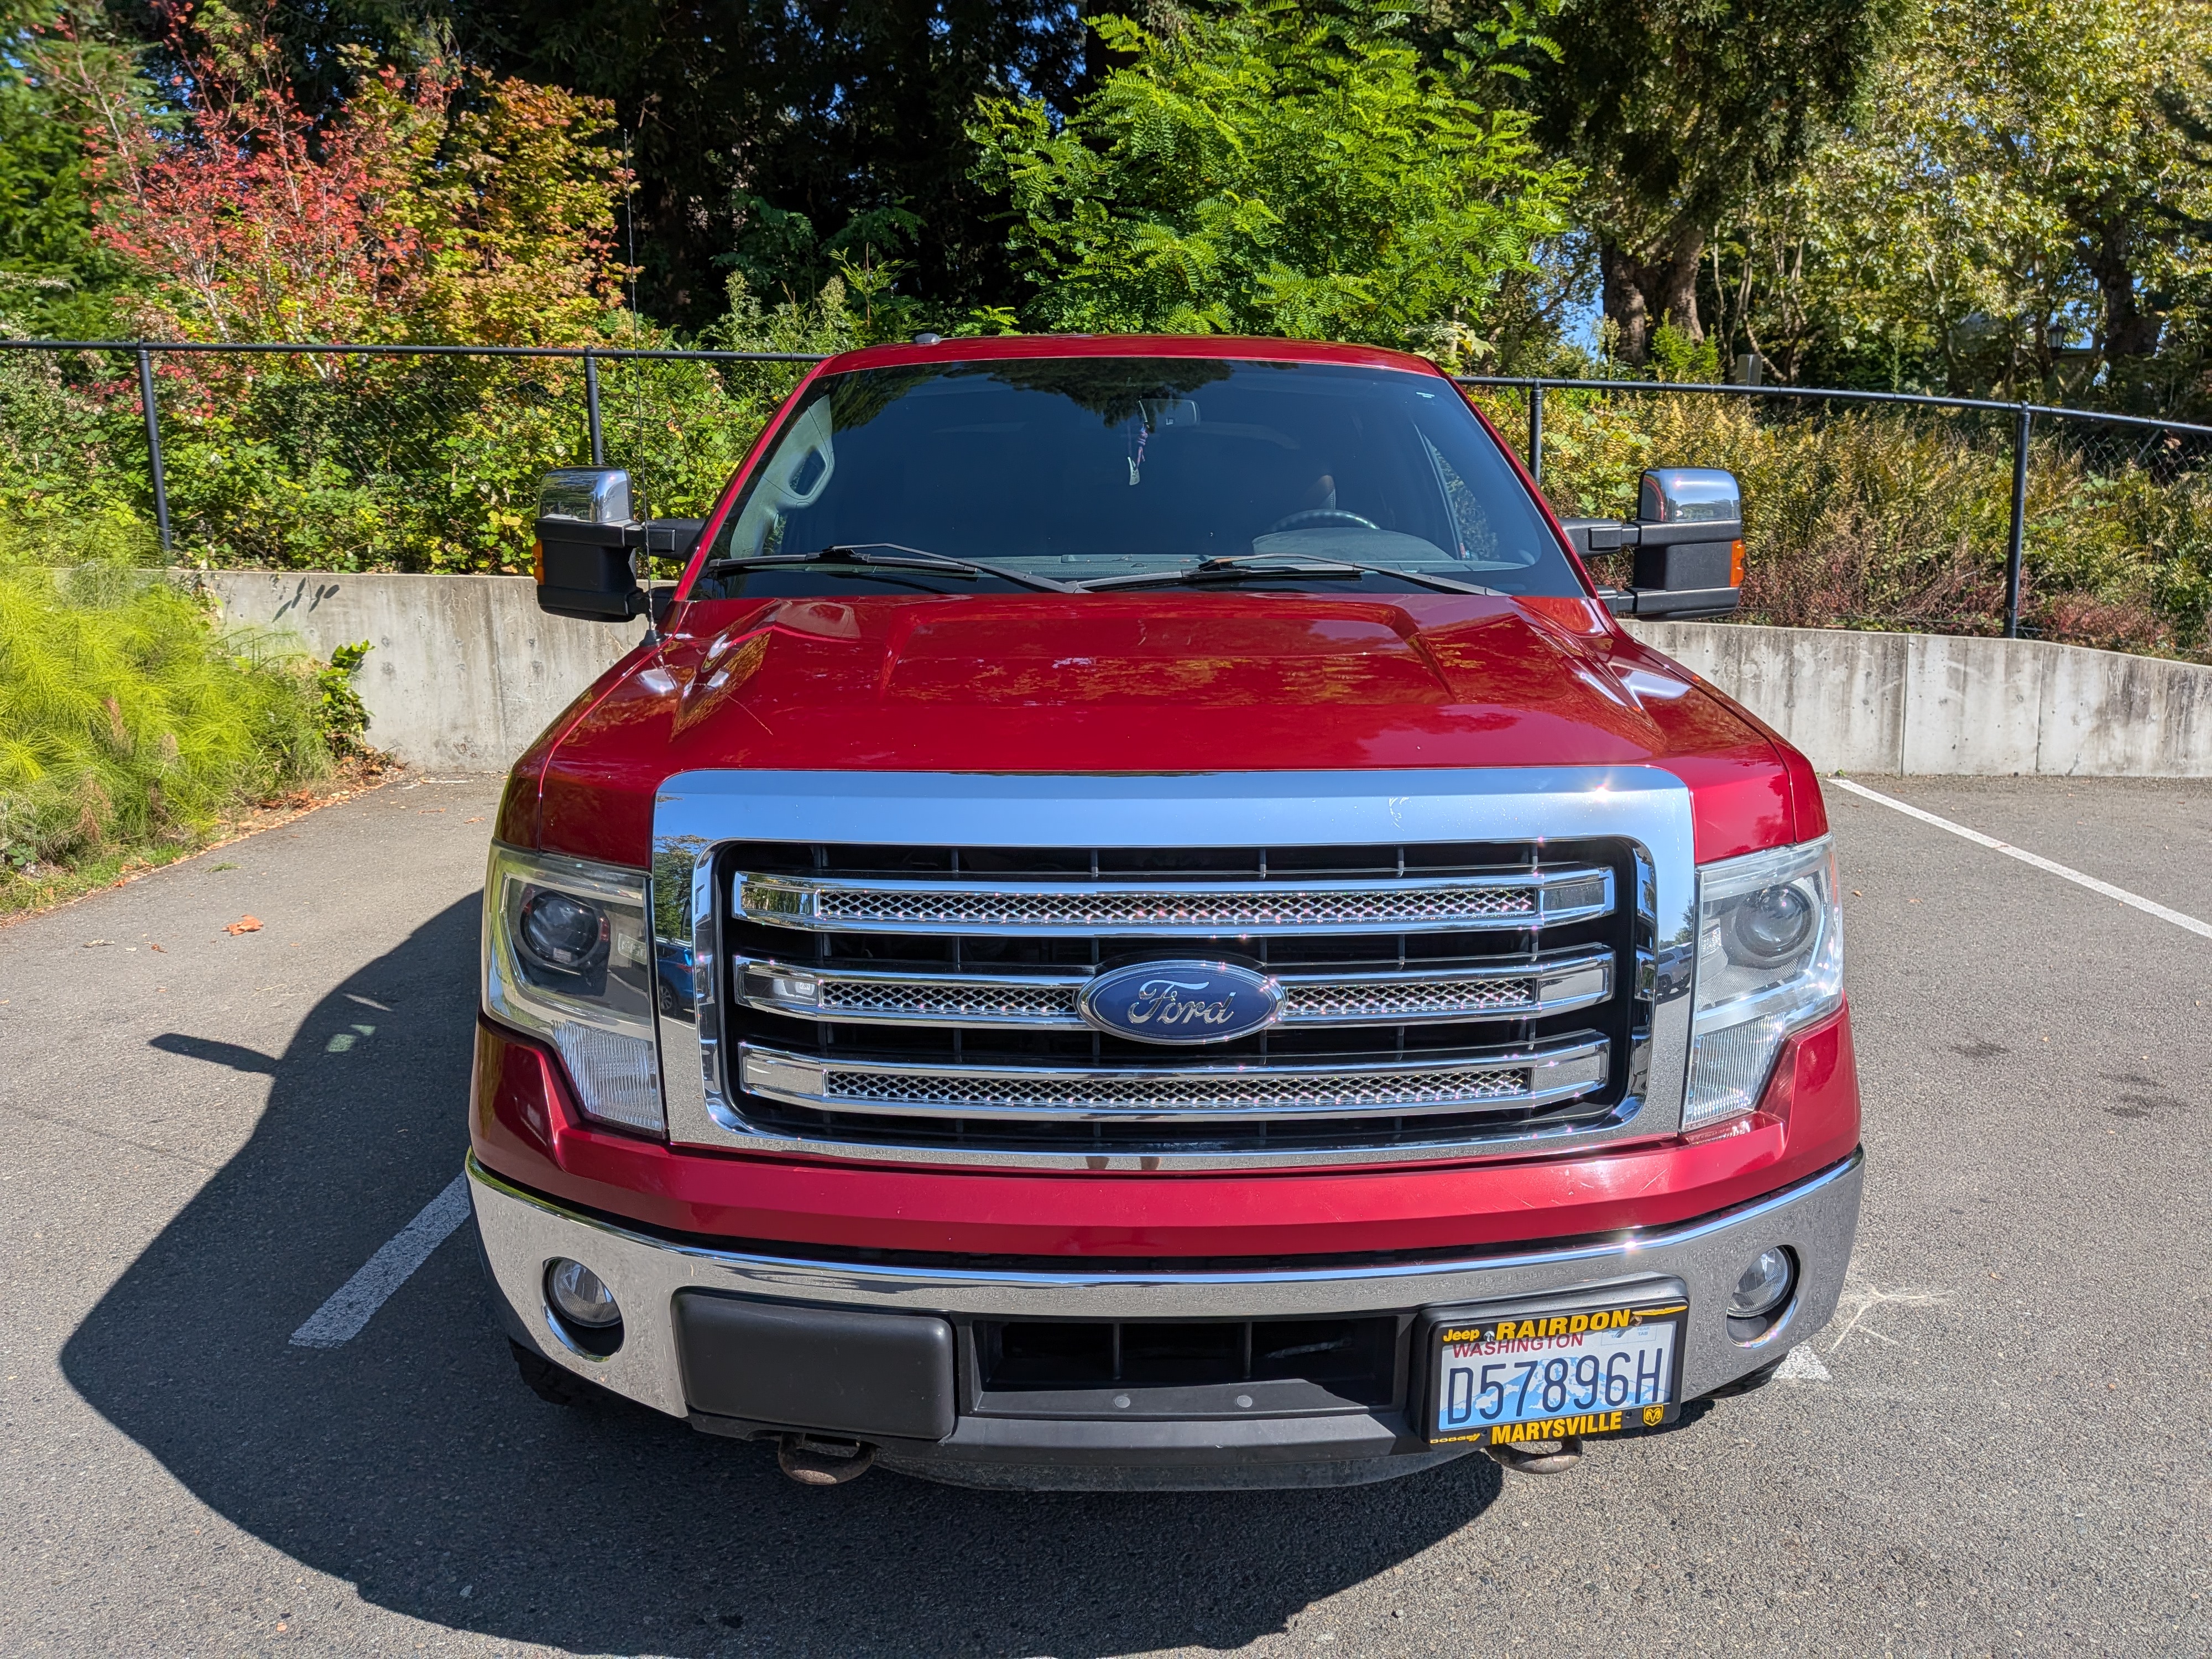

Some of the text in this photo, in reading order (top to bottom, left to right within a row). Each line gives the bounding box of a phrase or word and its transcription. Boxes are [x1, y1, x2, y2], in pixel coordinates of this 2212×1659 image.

[1128, 980, 1237, 1024] Ford
[1443, 1310, 1630, 1342] Jeep RAIRDON
[1453, 1332, 1584, 1358] WASHINGTON
[1447, 1348, 1662, 1425] D57896H
[1491, 1411, 1622, 1444] MARYSVILLE
